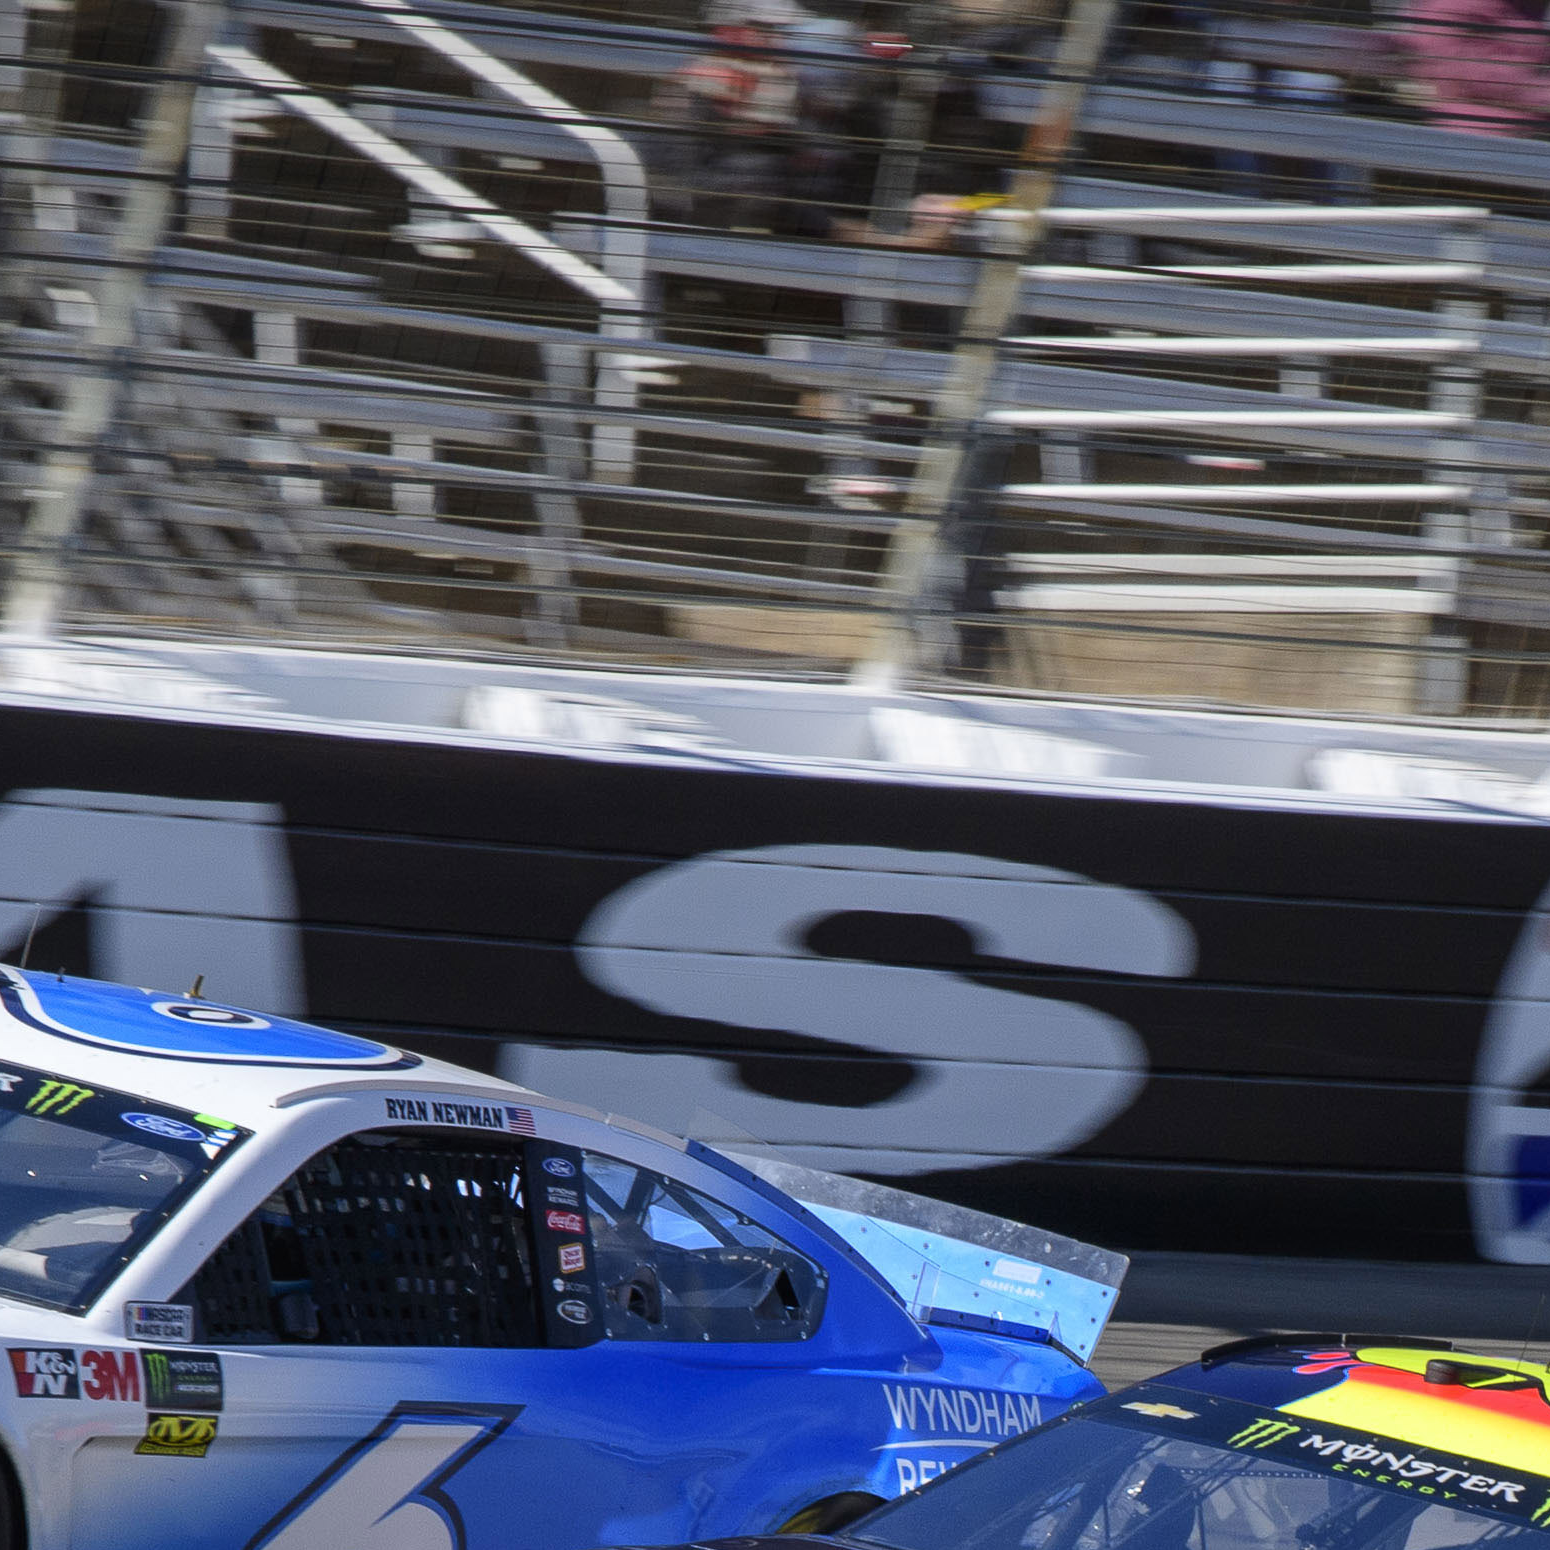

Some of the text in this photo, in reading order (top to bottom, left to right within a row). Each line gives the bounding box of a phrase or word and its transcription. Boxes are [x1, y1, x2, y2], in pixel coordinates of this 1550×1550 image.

[385, 1098, 504, 1128] RYAN NEWMAN
[80, 1350, 140, 1402] 3M
[882, 1383, 1042, 1436] WYNDHAM
[1299, 1434, 1526, 1503] MONSTER
[1331, 1463, 1456, 1499] ENERGY
